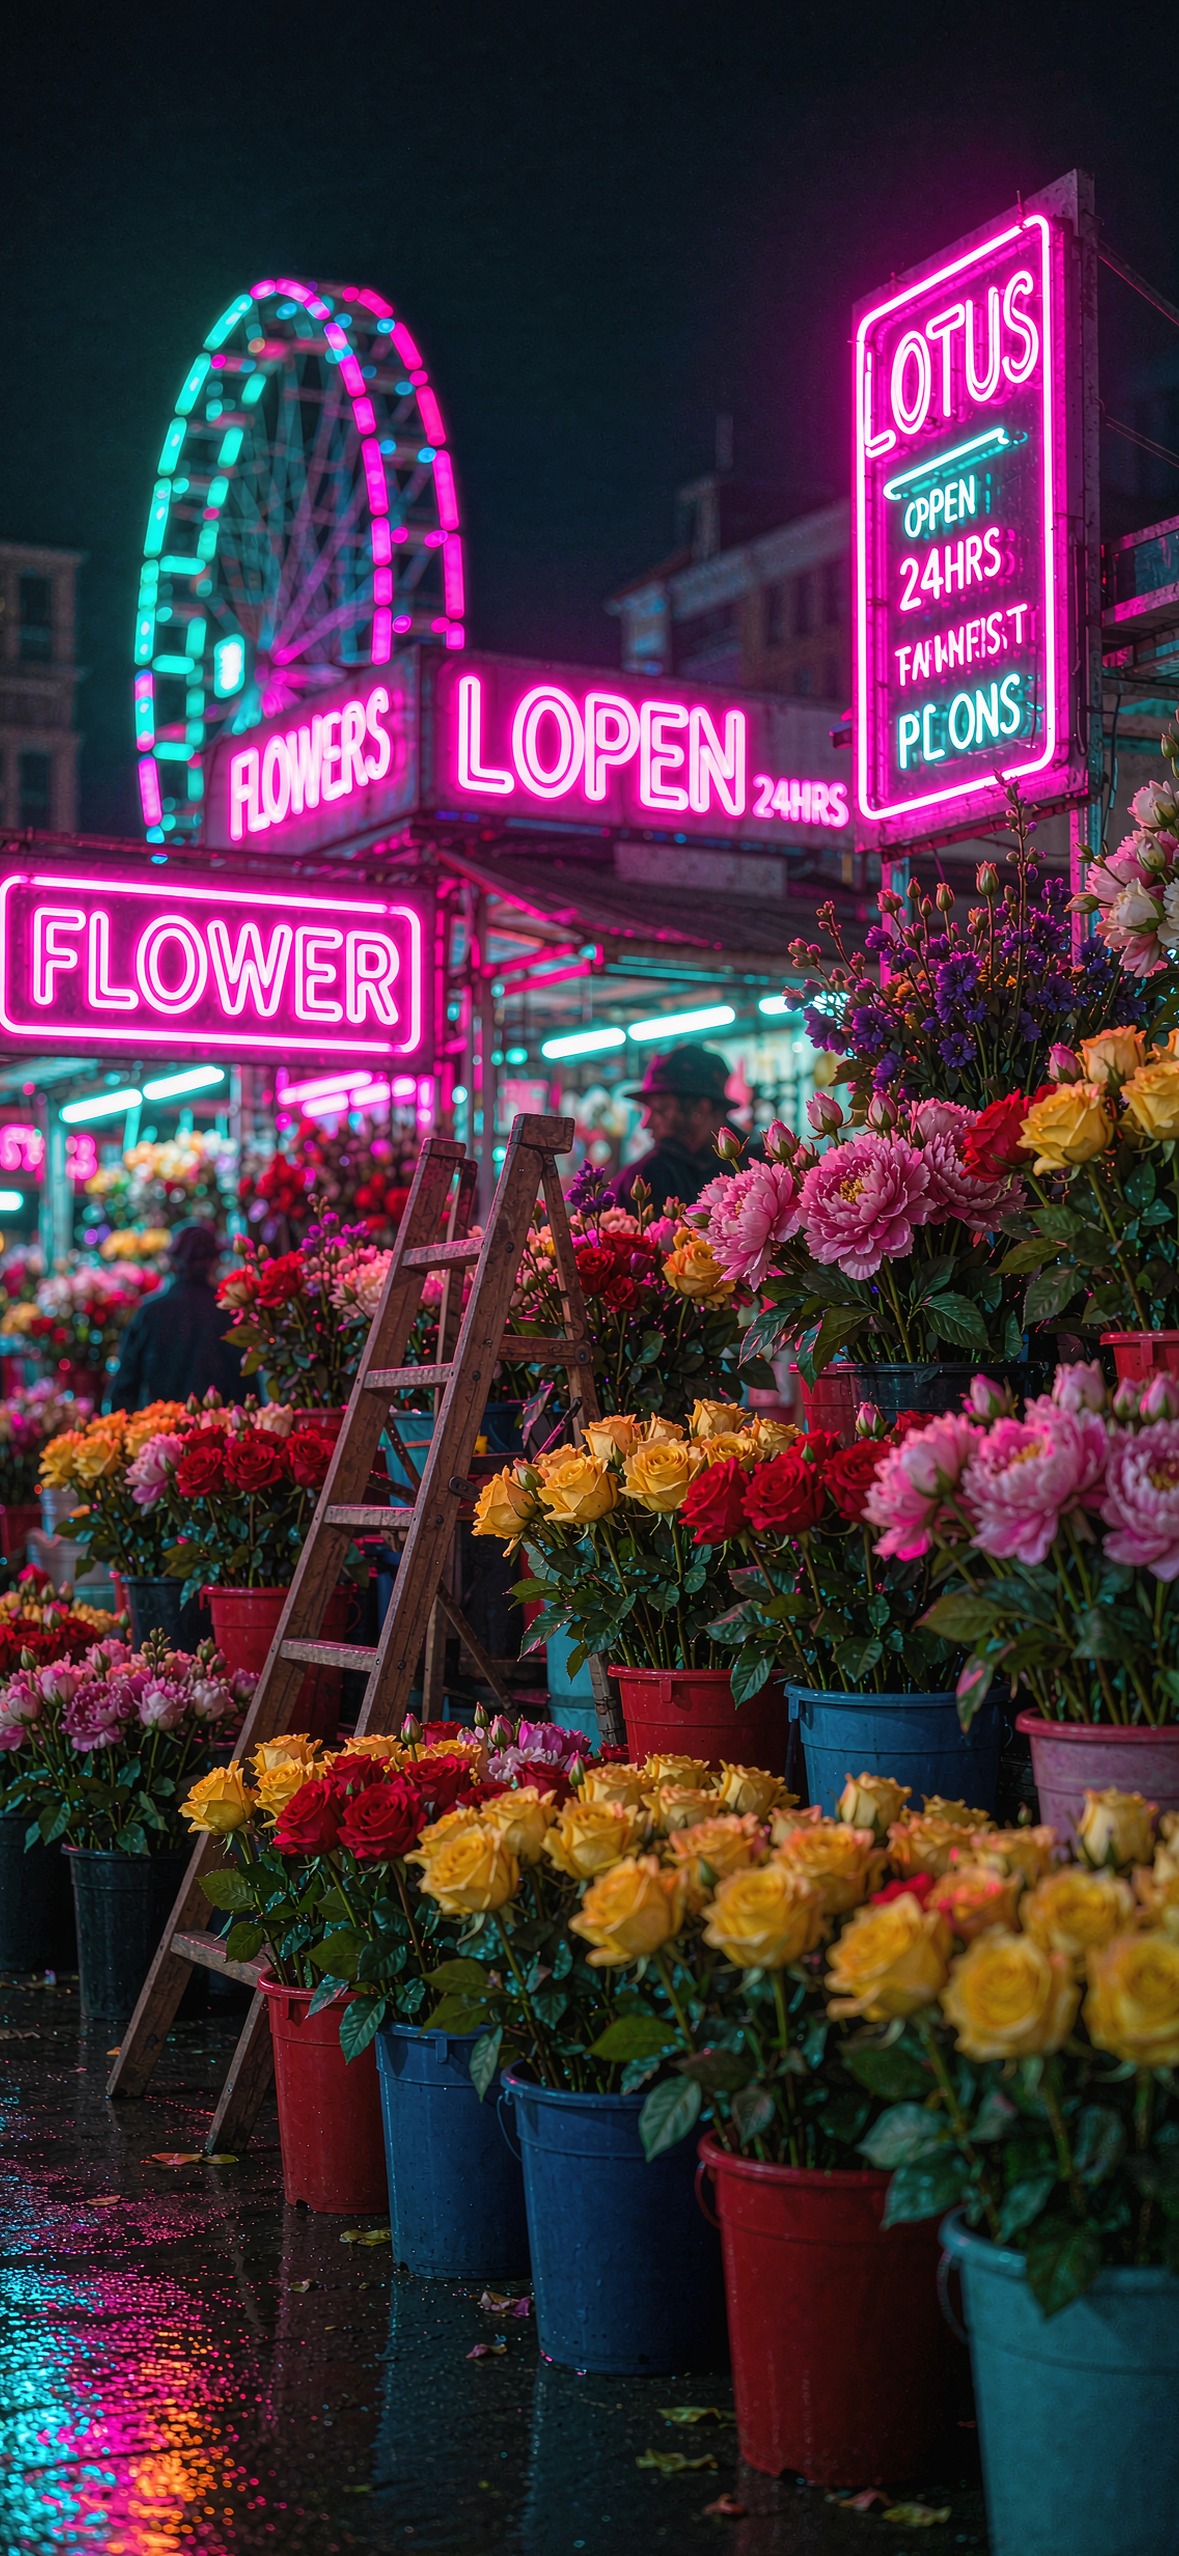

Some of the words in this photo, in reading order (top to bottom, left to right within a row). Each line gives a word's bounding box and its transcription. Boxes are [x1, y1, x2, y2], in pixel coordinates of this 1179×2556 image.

[864, 269, 1039, 459] LOTUS
[899, 526, 1002, 611] 24HRS
[230, 686, 391, 841] FLOWERS
[458, 675, 746, 816] LOPEN
[752, 773, 850, 828] 24HRS
[33, 906, 400, 1025] FLOWER
